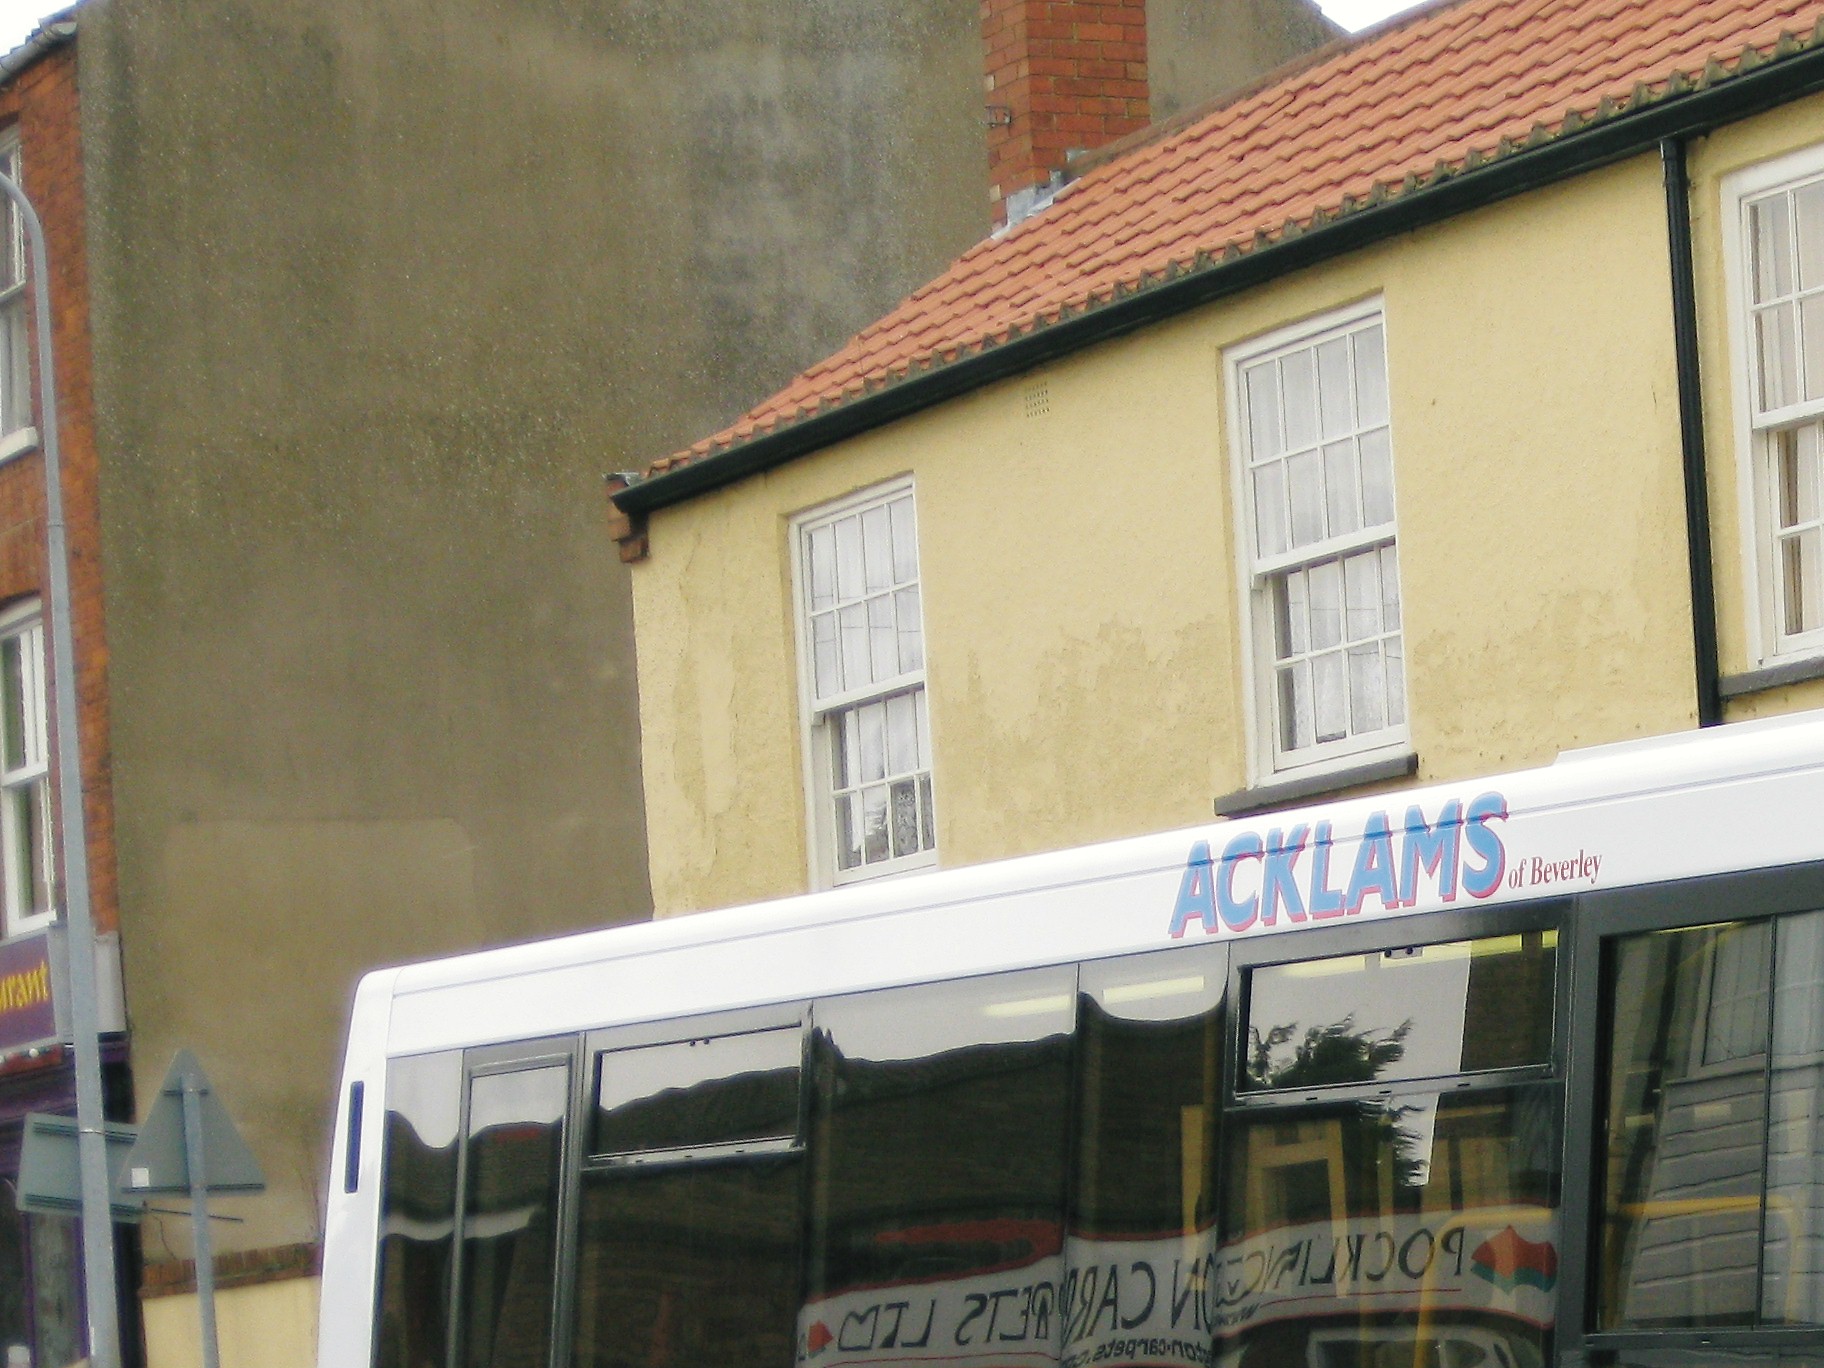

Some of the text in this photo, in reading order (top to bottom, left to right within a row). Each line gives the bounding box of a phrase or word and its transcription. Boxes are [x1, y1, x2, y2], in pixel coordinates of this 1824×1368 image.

[1168, 791, 1603, 939] ACKLAMS of Beverley
